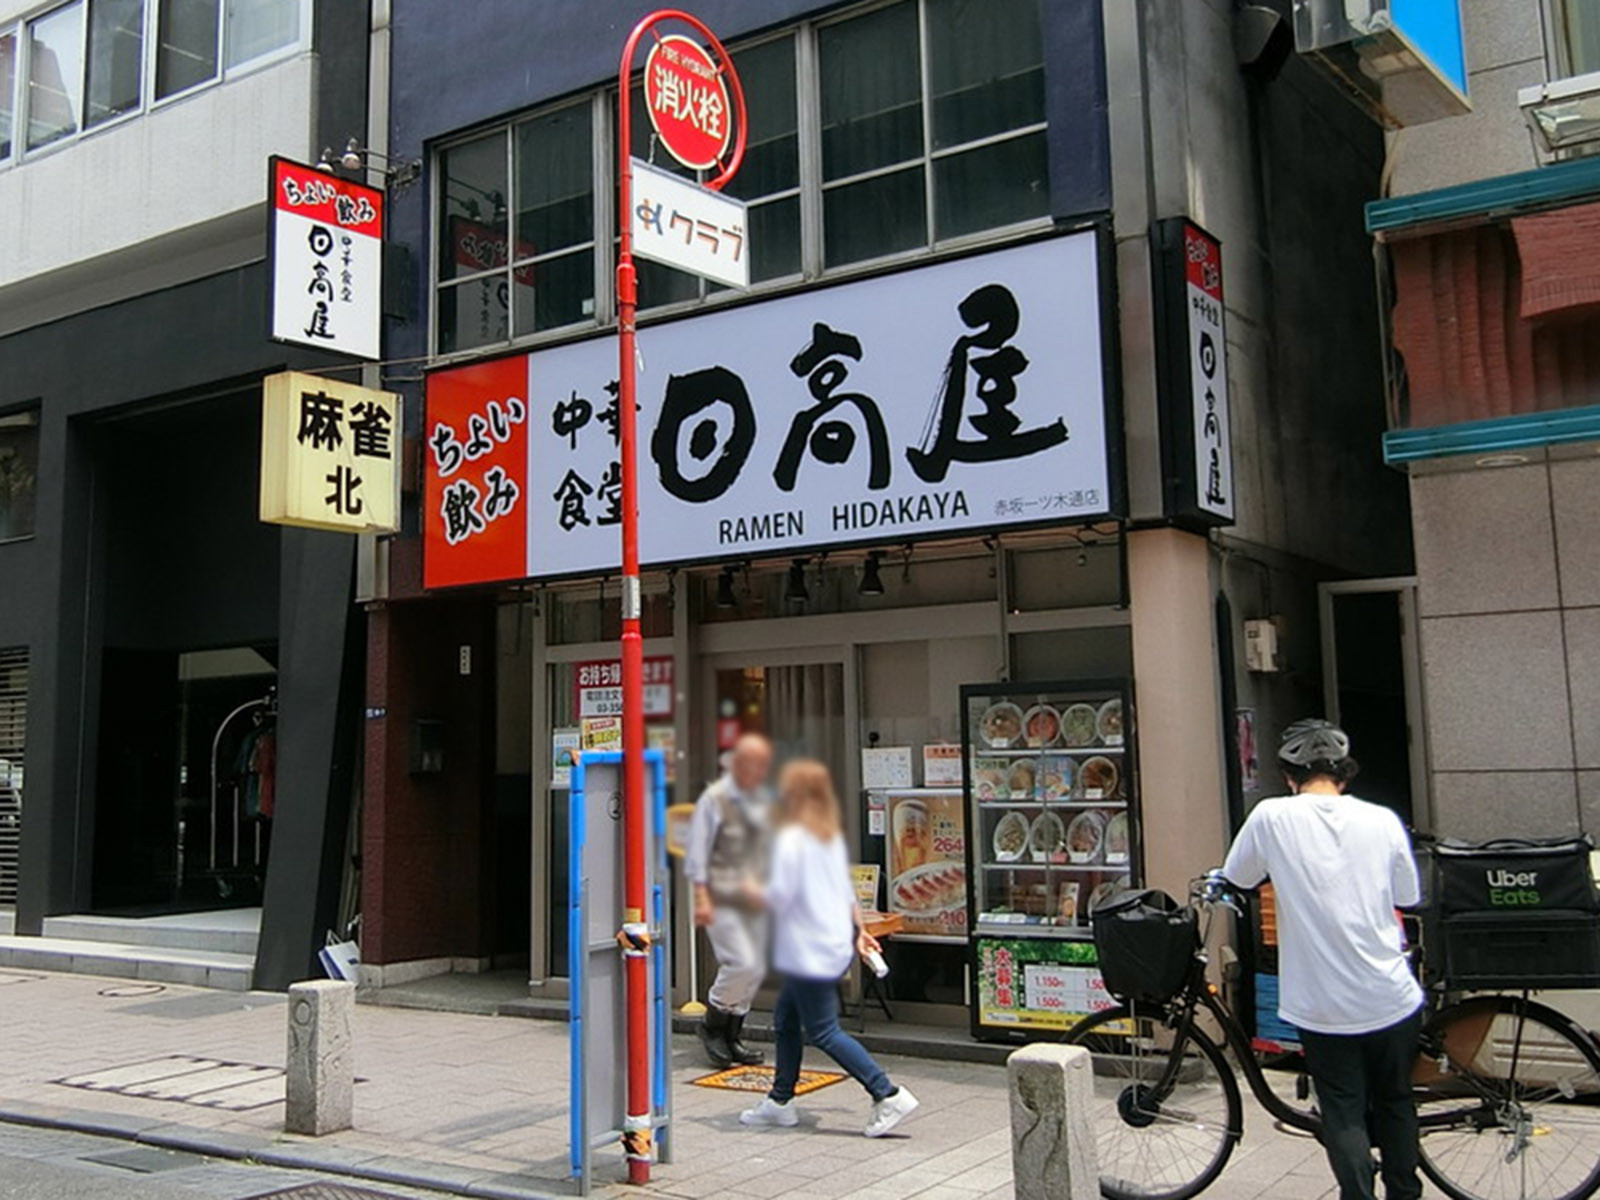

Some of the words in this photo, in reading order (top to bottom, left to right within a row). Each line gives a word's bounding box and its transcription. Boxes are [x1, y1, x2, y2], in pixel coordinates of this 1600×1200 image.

[655, 64, 723, 139] 消火栓
[305, 224, 335, 340] 日高屋
[298, 391, 392, 460] 麻雀
[651, 283, 1069, 503] 日高屋
[1200, 331, 1225, 507] 日高屋
[431, 399, 523, 475] ちょい
[325, 464, 362, 515] 北
[442, 468, 518, 544] 飲み
[719, 510, 804, 545] RAMEN
[832, 491, 969, 532] HIDAKAYA
[1486, 870, 1538, 887] Uber
[1490, 889, 1540, 904] Eats
